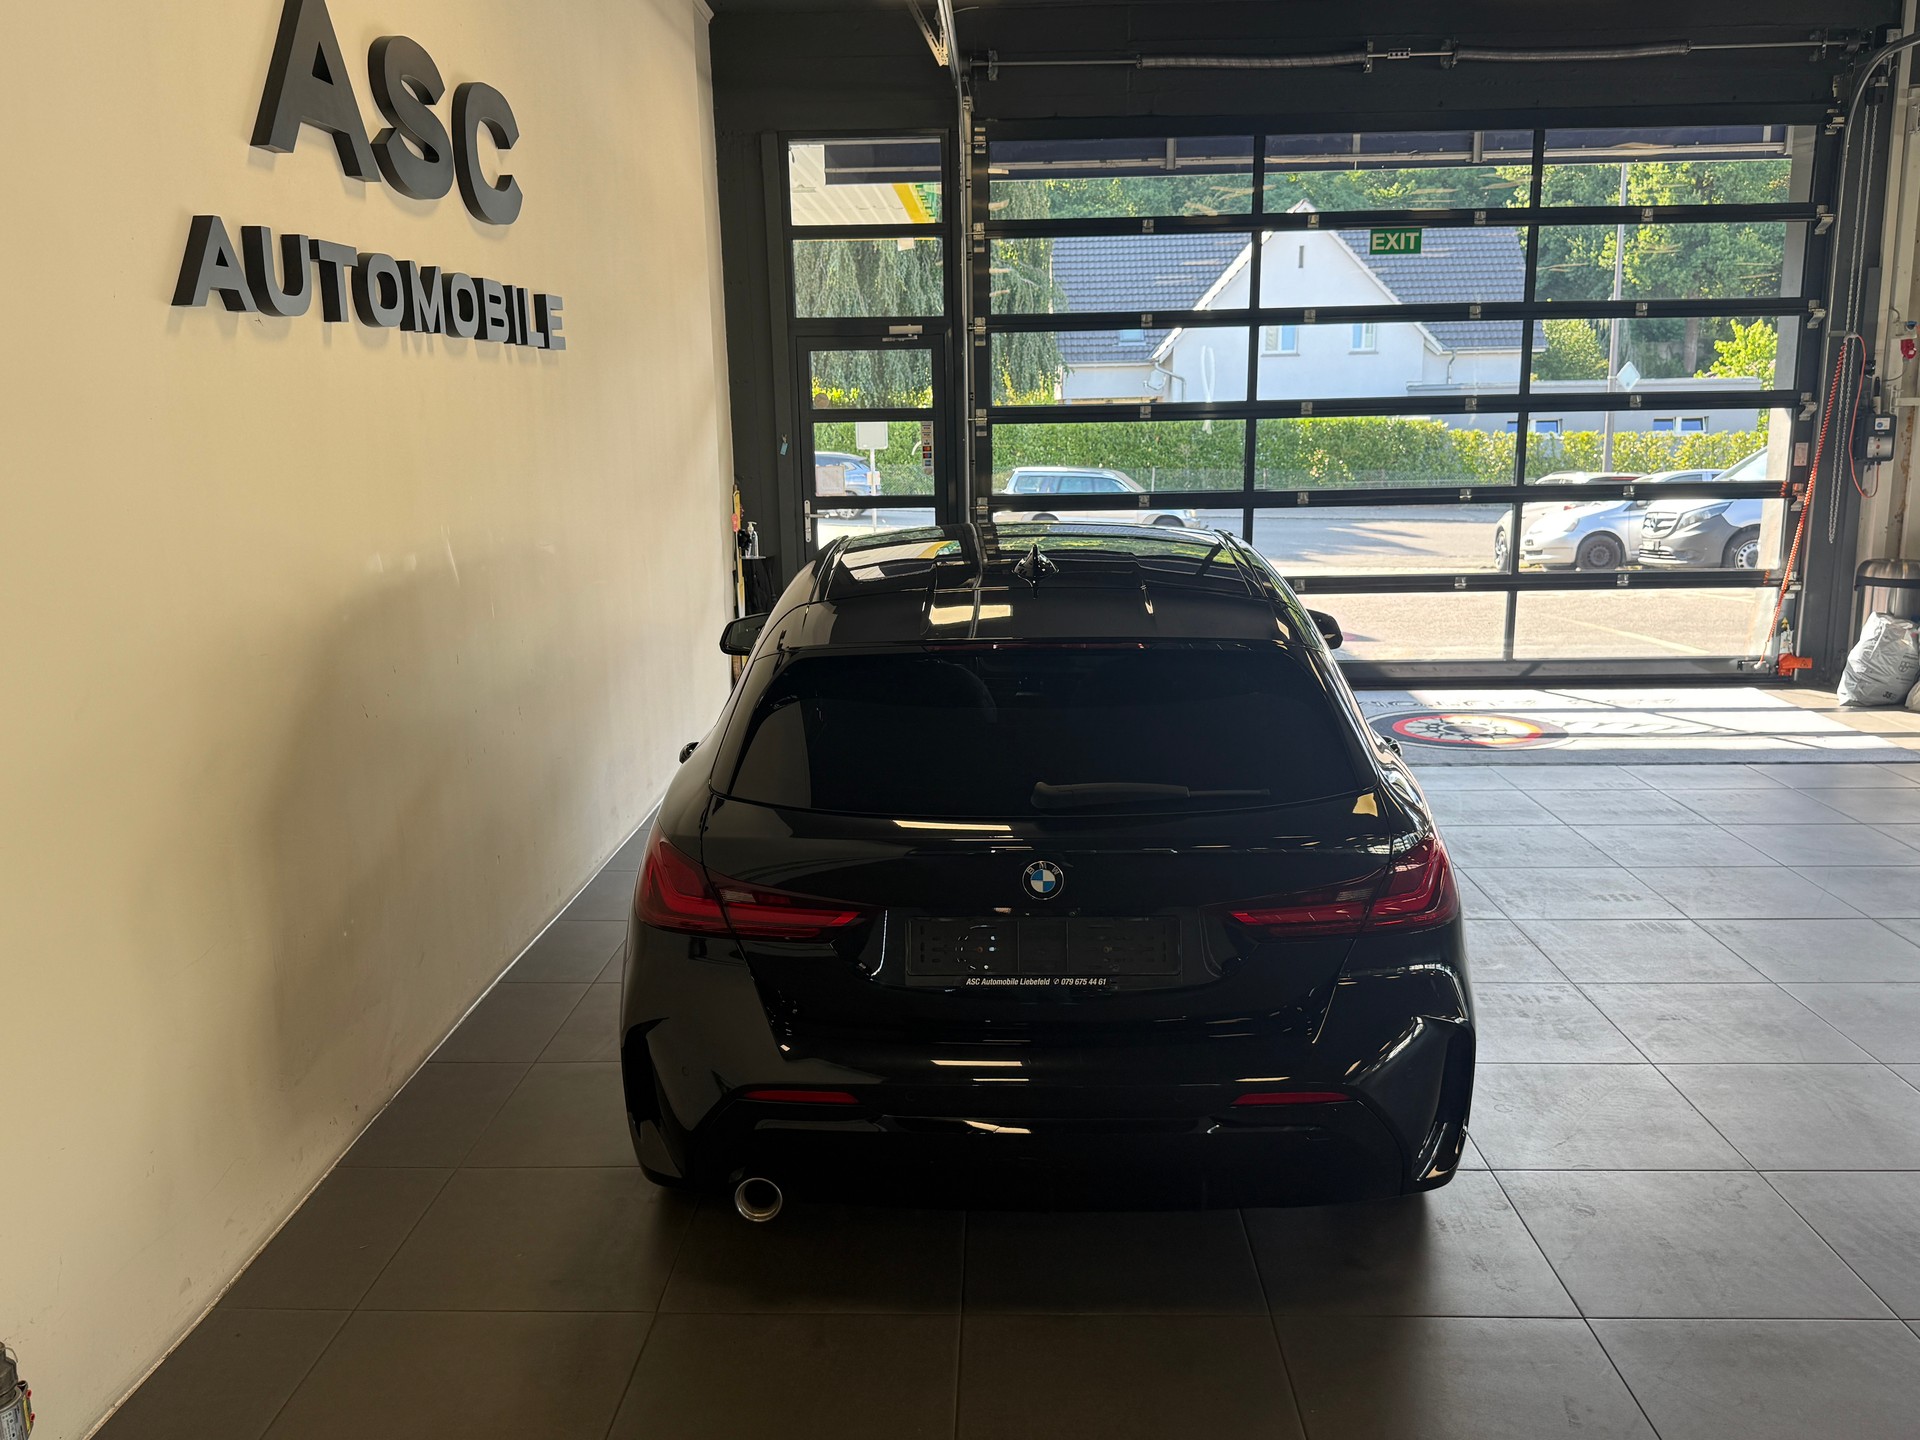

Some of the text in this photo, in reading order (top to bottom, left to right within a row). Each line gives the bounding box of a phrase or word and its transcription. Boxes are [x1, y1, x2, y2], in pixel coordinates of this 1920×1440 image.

[250, 0, 523, 225] ASC
[1371, 232, 1420, 250] EXIT
[171, 215, 566, 350] AUTOMOBILE
[1026, 861, 1060, 875] BMW
[966, 978, 1107, 986] ASC Automobile Liebefeld 079 675 44 61
